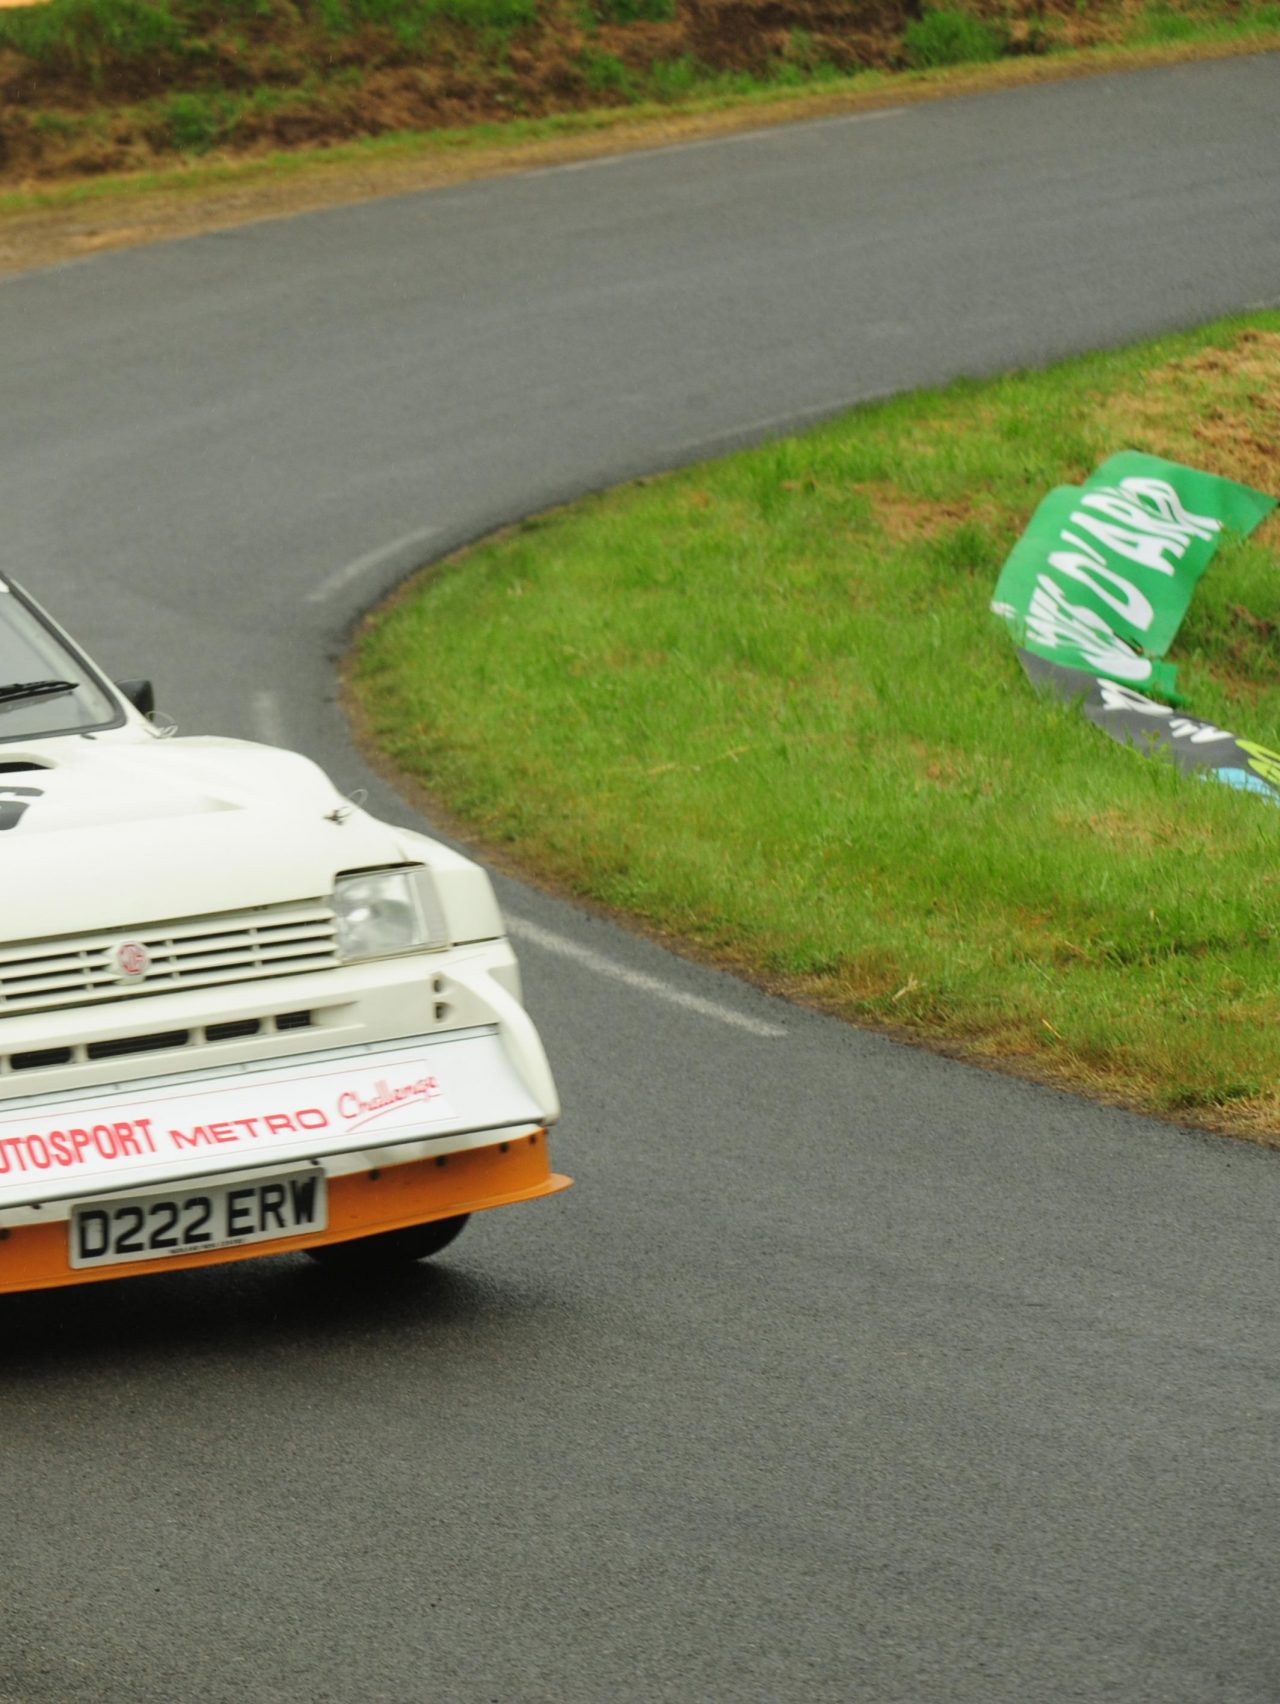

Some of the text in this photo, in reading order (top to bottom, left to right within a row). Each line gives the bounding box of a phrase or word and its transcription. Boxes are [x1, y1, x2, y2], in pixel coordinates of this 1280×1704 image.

[168, 1107, 331, 1150] METRO
[337, 1074, 440, 1122] Challenge
[80, 1176, 318, 1259] D222 ERW
